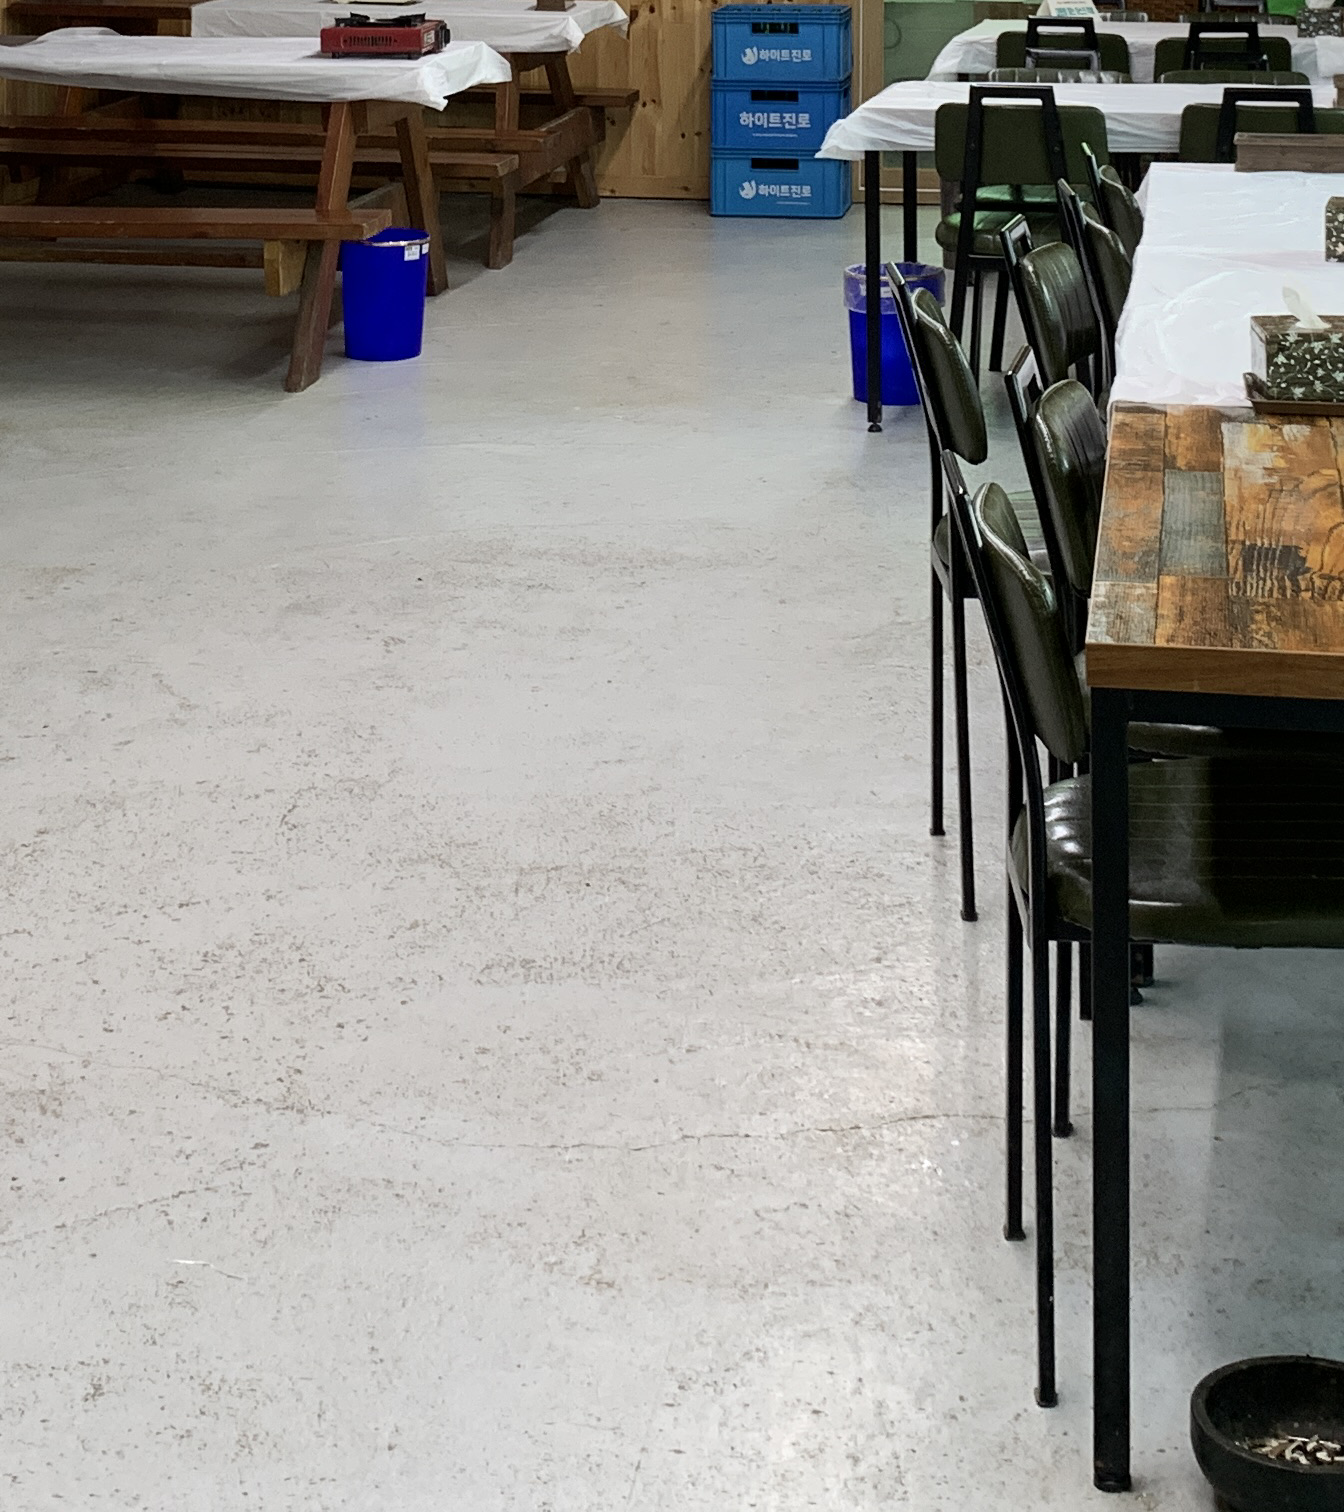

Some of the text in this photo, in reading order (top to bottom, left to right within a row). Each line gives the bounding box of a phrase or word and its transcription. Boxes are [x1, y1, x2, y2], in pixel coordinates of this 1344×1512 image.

[758, 49, 813, 63] 하이트진로
[739, 111, 811, 130] 하이트진로
[758, 184, 812, 198] 하이트진로
